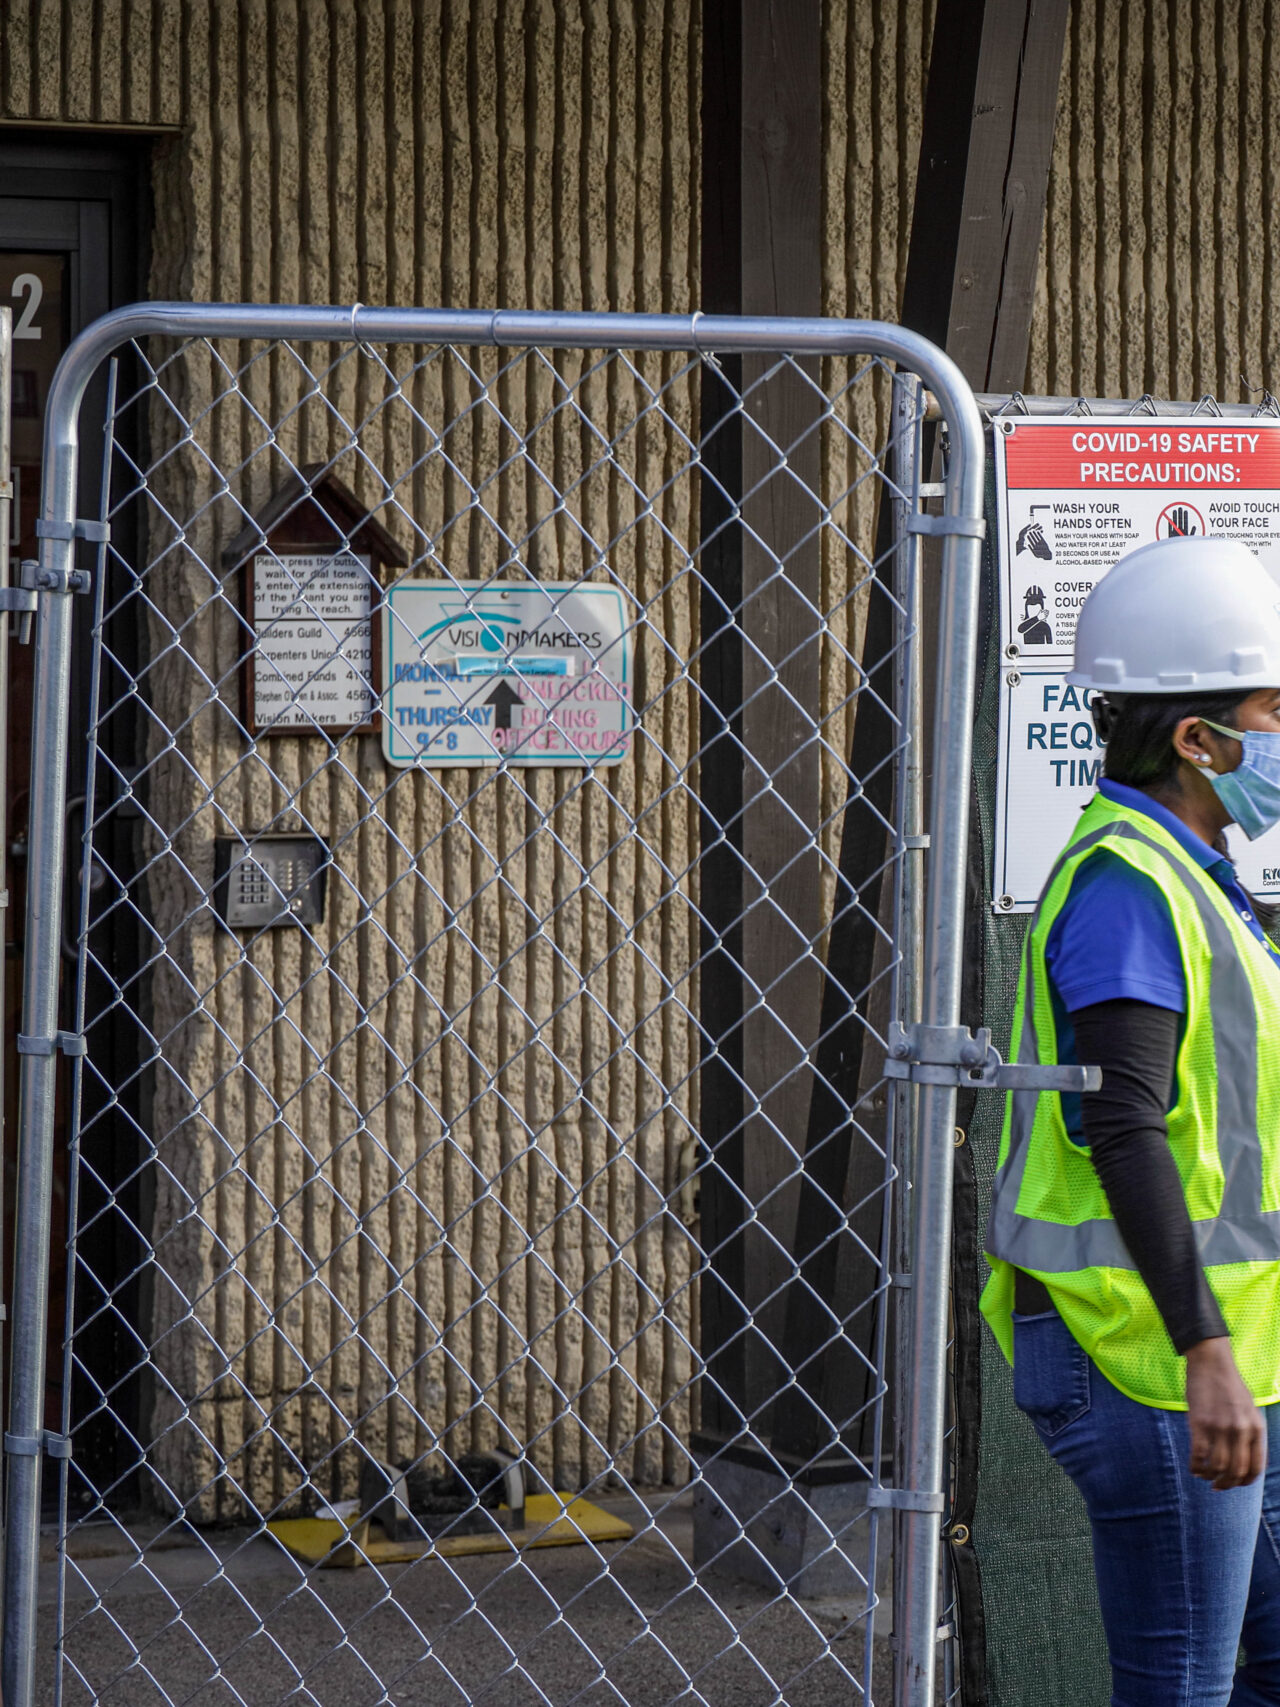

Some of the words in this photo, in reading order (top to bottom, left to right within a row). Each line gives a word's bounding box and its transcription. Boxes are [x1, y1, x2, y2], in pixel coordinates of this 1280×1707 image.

[11, 273, 43, 339] 2
[1072, 432, 1172, 453] COVID-19
[1178, 433, 1260, 453] SAFETY
[1080, 462, 1241, 483] PRECAUTIONS:
[1053, 503, 1086, 514] WASH
[1089, 503, 1120, 514] YOUR
[1209, 503, 1241, 513] AVOID
[1053, 518, 1092, 529] HANDS
[1095, 518, 1132, 529] OFTEN
[1209, 517, 1239, 528] YOUR
[1242, 517, 1269, 528] FACE
[256, 556, 285, 566] Pleae
[288, 558, 313, 568] press
[333, 556, 359, 566] butto
[265, 569, 285, 579] wait
[291, 569, 305, 579] for
[266, 582, 293, 590] enter
[320, 581, 371, 590] extension
[1054, 581, 1093, 592] COVER
[255, 592, 265, 602] of
[270, 592, 287, 602] the
[292, 593, 325, 602] tnant
[329, 594, 349, 605] you
[352, 594, 370, 602] are
[1054, 597, 1087, 607] COUG
[321, 605, 353, 614] reach.
[296, 627, 322, 639] Guild
[311, 649, 338, 660] Unio
[345, 649, 371, 660] 4210
[517, 681, 632, 701] UNLOCKED
[1043, 685, 1096, 712] FAC
[295, 712, 337, 723] Makers
[396, 706, 494, 727] THURSDAY
[521, 707, 601, 728] DURING
[416, 732, 430, 751] 9
[446, 732, 459, 751] 8
[490, 728, 560, 750] OFFICE
[564, 730, 632, 751] HOURS
[1049, 759, 1102, 787] TIM
